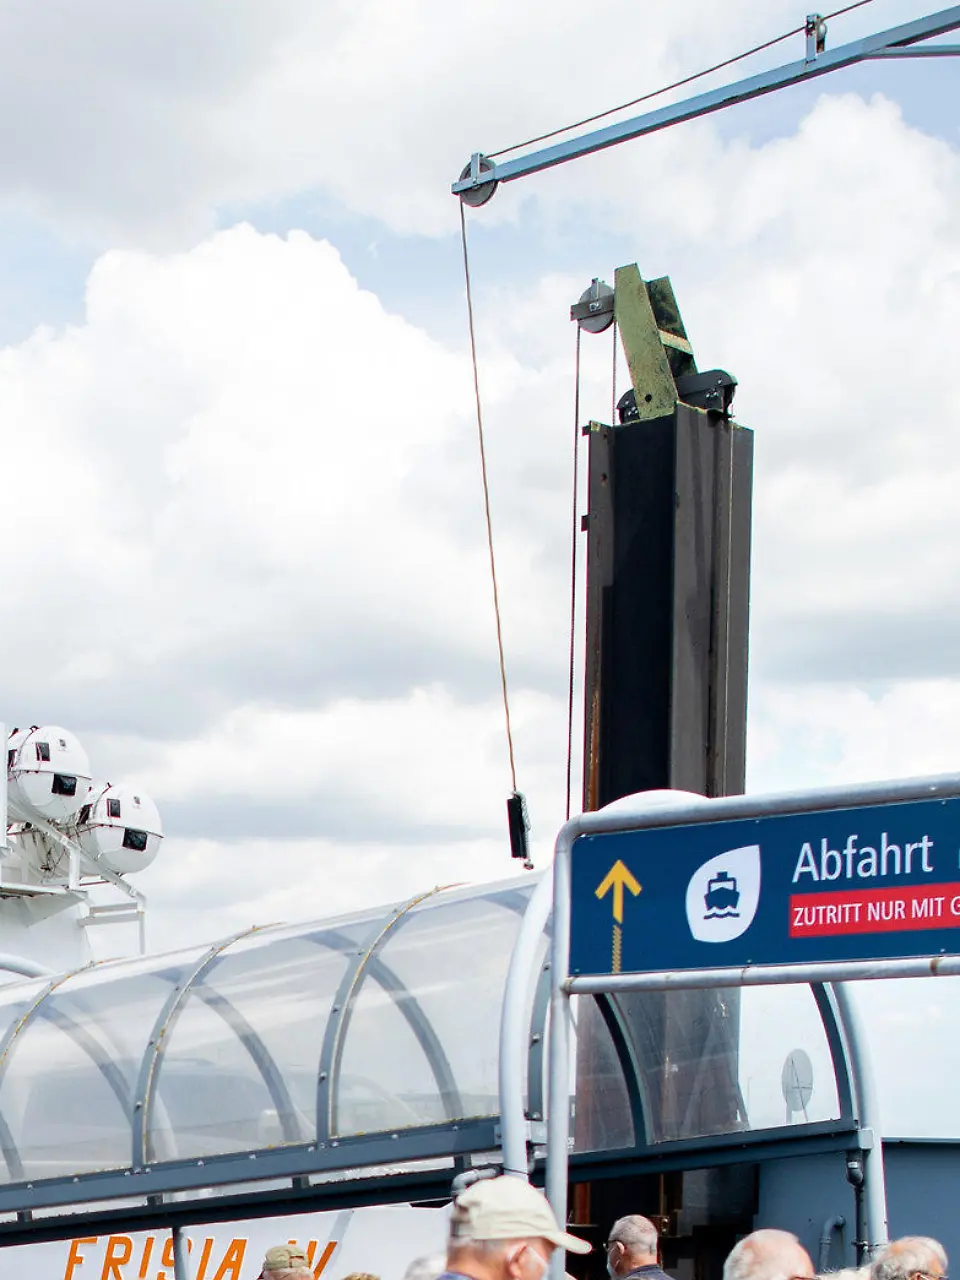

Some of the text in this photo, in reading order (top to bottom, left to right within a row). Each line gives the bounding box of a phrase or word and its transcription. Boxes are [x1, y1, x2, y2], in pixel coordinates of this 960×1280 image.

[792, 832, 934, 883] Abfahrt
[793, 902, 862, 927] ZUTRITT
[867, 899, 906, 922] NUR
[911, 896, 945, 919] MIT
